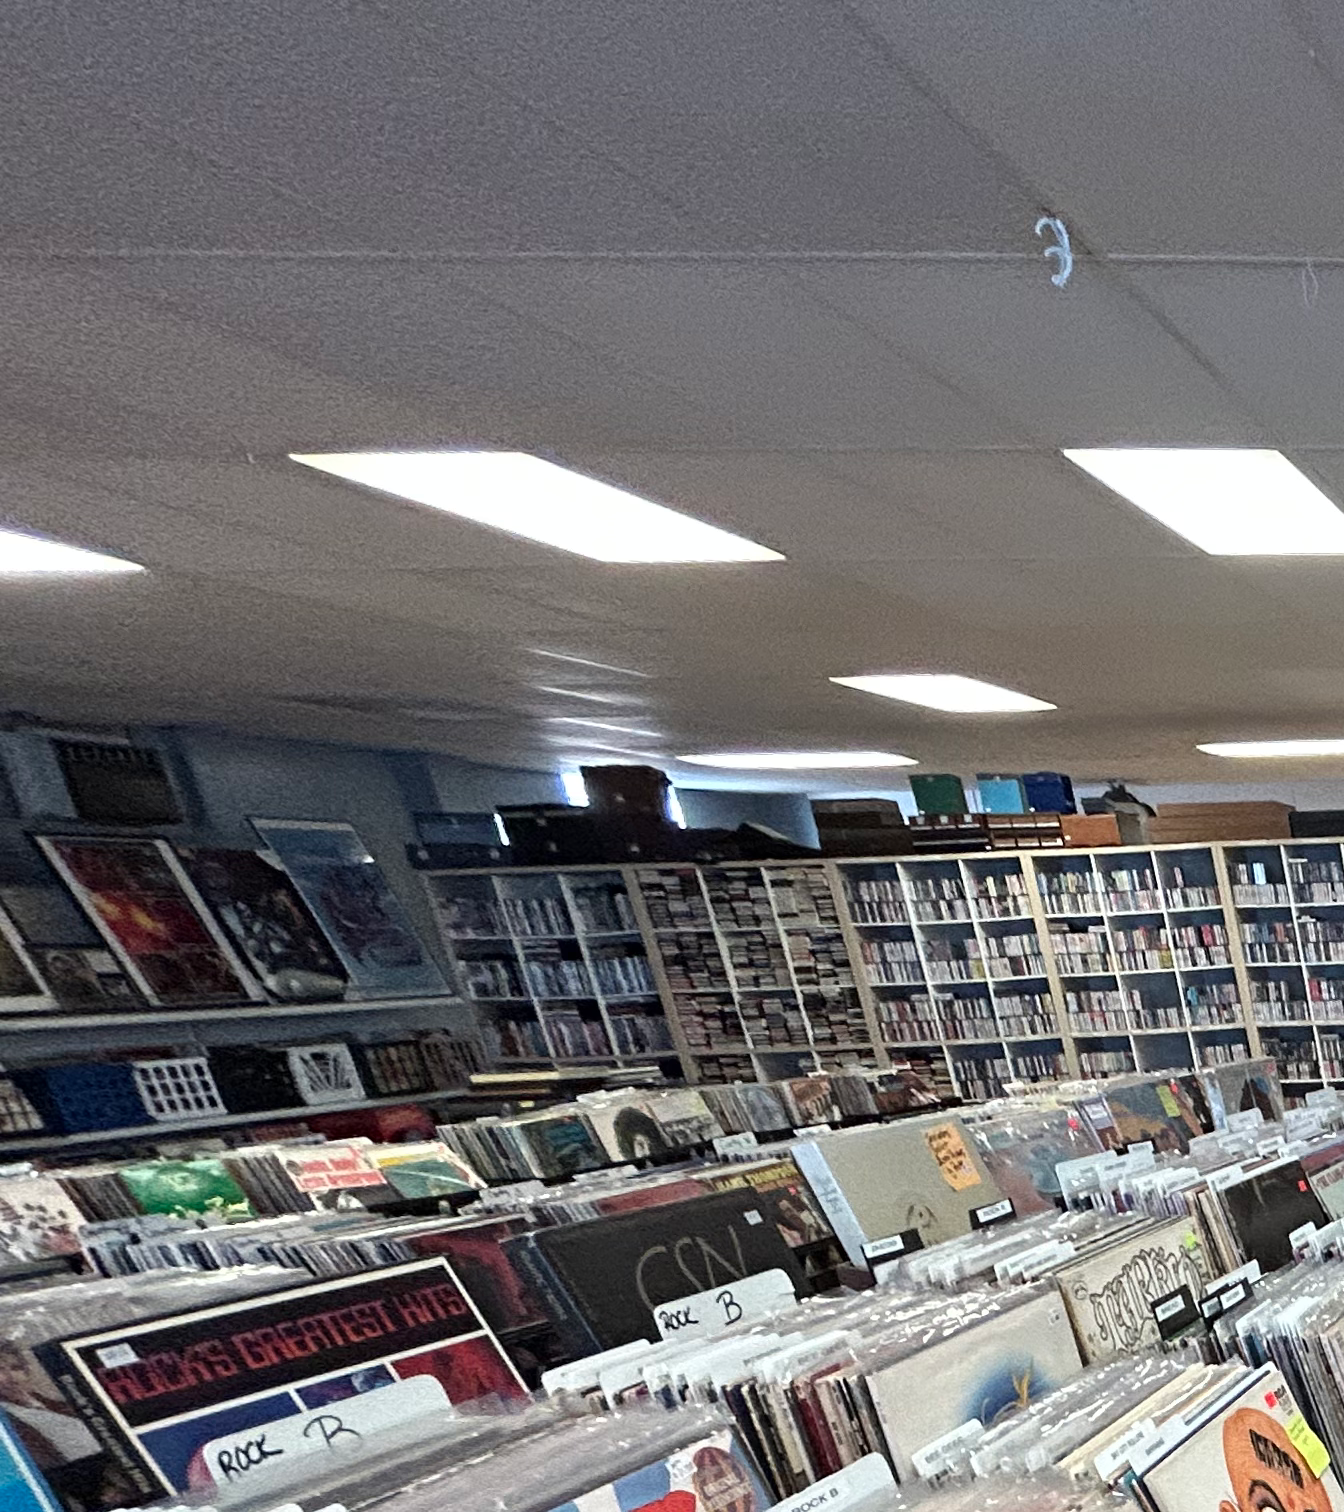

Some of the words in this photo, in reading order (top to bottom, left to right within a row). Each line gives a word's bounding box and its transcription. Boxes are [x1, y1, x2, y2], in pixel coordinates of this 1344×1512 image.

[234, 1299, 396, 1369] GREATEST
[393, 1282, 467, 1328] HITS
[658, 1304, 699, 1333] ROCK
[715, 1289, 743, 1327] B
[217, 1431, 284, 1479] ROCK
[827, 1486, 841, 1500] B
